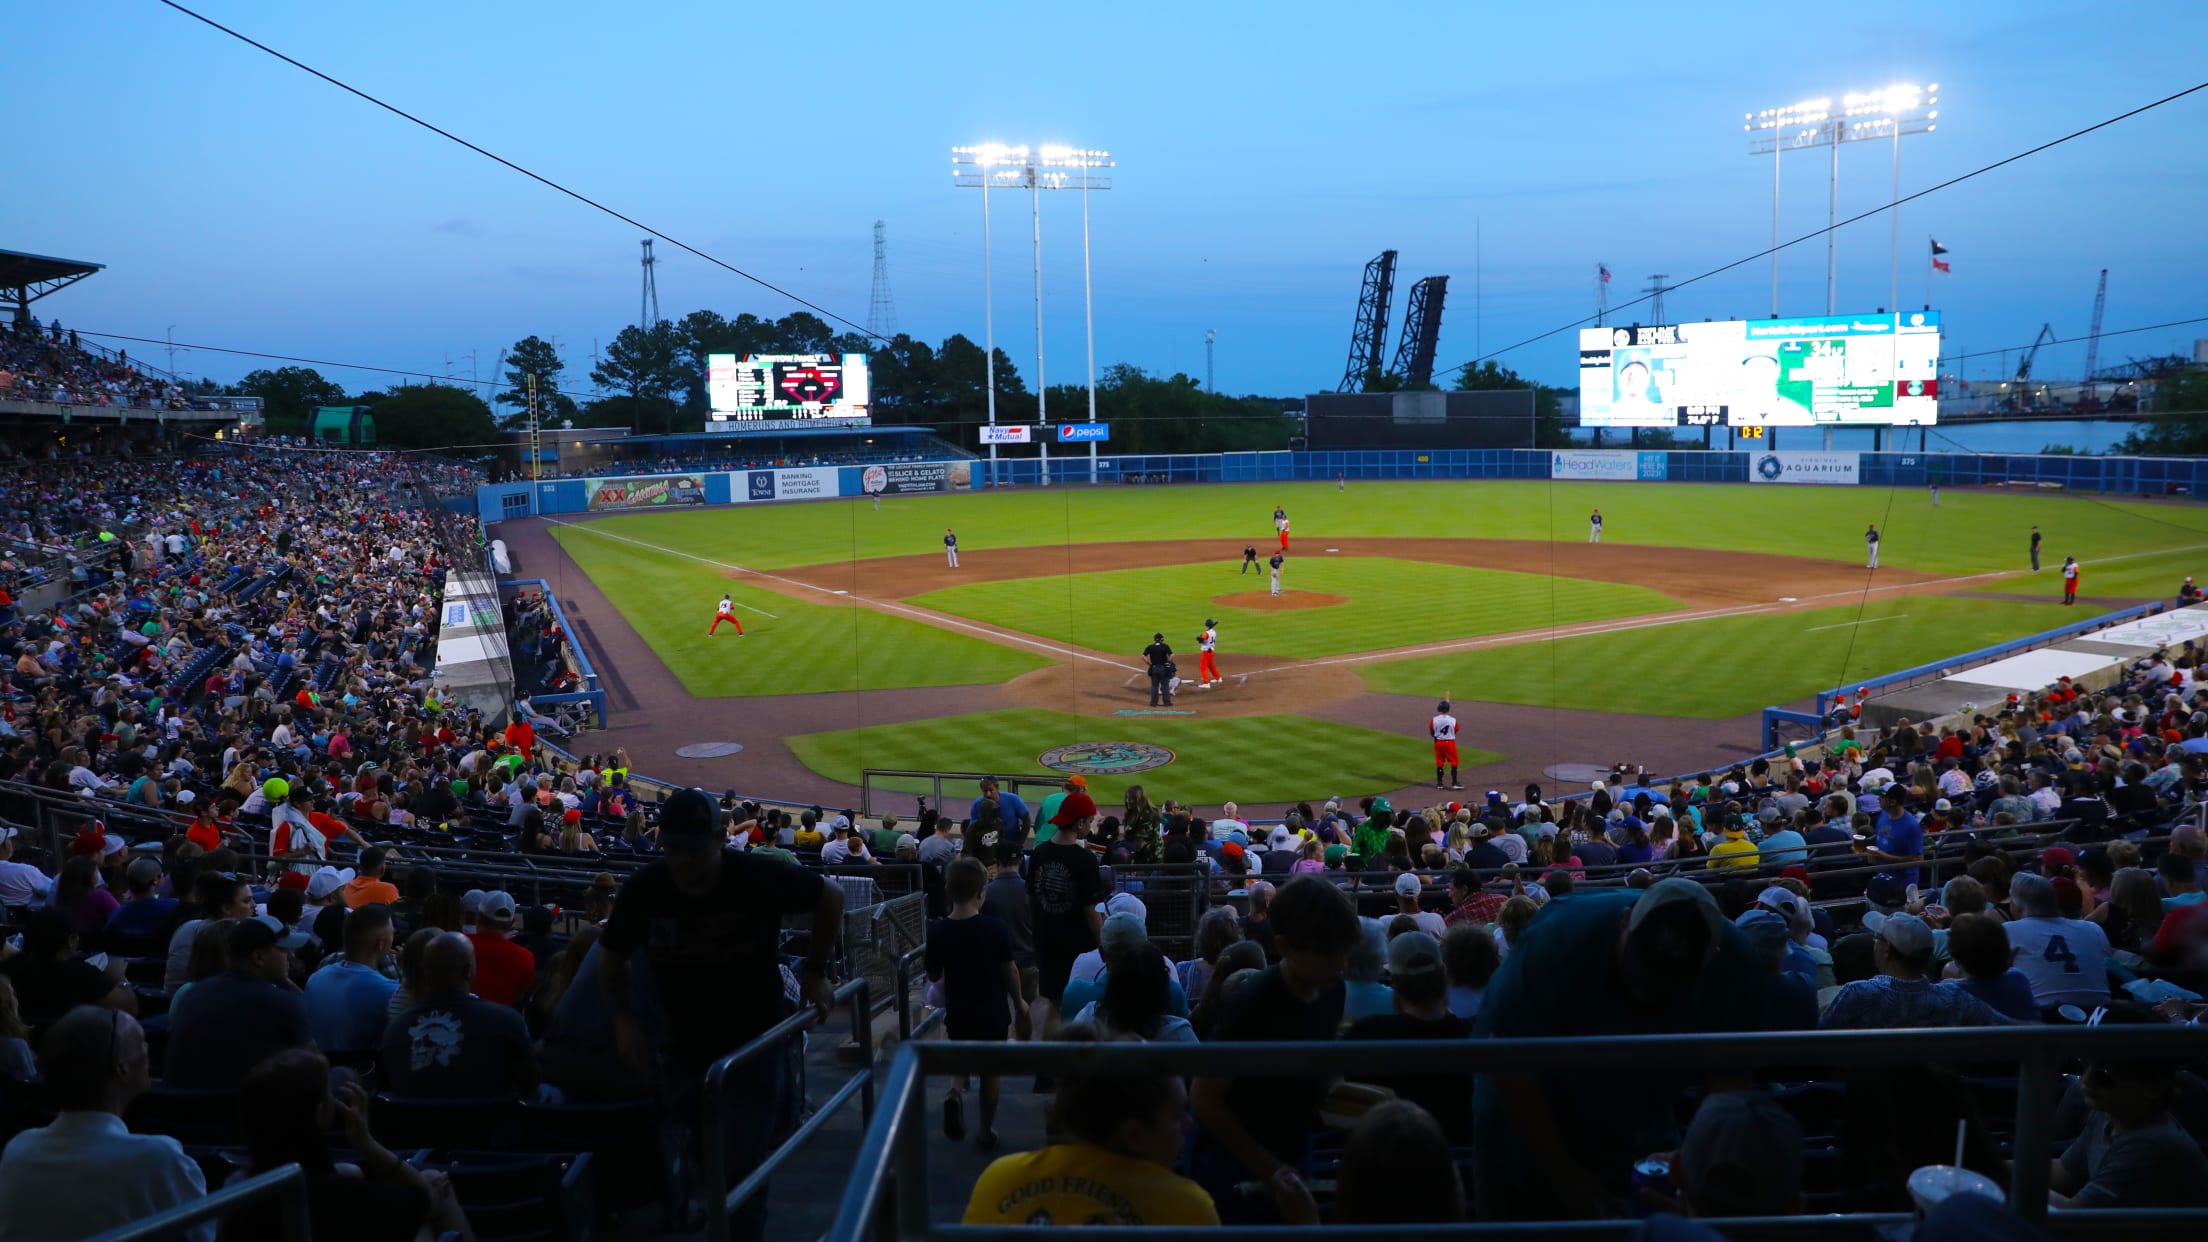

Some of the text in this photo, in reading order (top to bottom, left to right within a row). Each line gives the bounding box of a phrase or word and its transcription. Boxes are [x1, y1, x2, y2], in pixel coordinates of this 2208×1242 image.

[728, 420, 776, 431] HOMERUNS
[778, 419, 797, 429] AND
[989, 427, 1009, 436] Navy
[1077, 427, 1104, 438] pepsi
[994, 433, 1022, 441] Mutual
[1563, 458, 1633, 472] HeadWaters
[1786, 464, 1852, 473] AQUARIUM
[920, 468, 945, 476] GELATO
[781, 473, 812, 481] BANKING
[782, 480, 820, 488] MORTGAGE
[782, 487, 820, 495] INSURANCE
[1440, 725, 1450, 735] 4
[2044, 934, 2080, 973] 4
[998, 1175, 1144, 1225] GOOD FRIENDS
